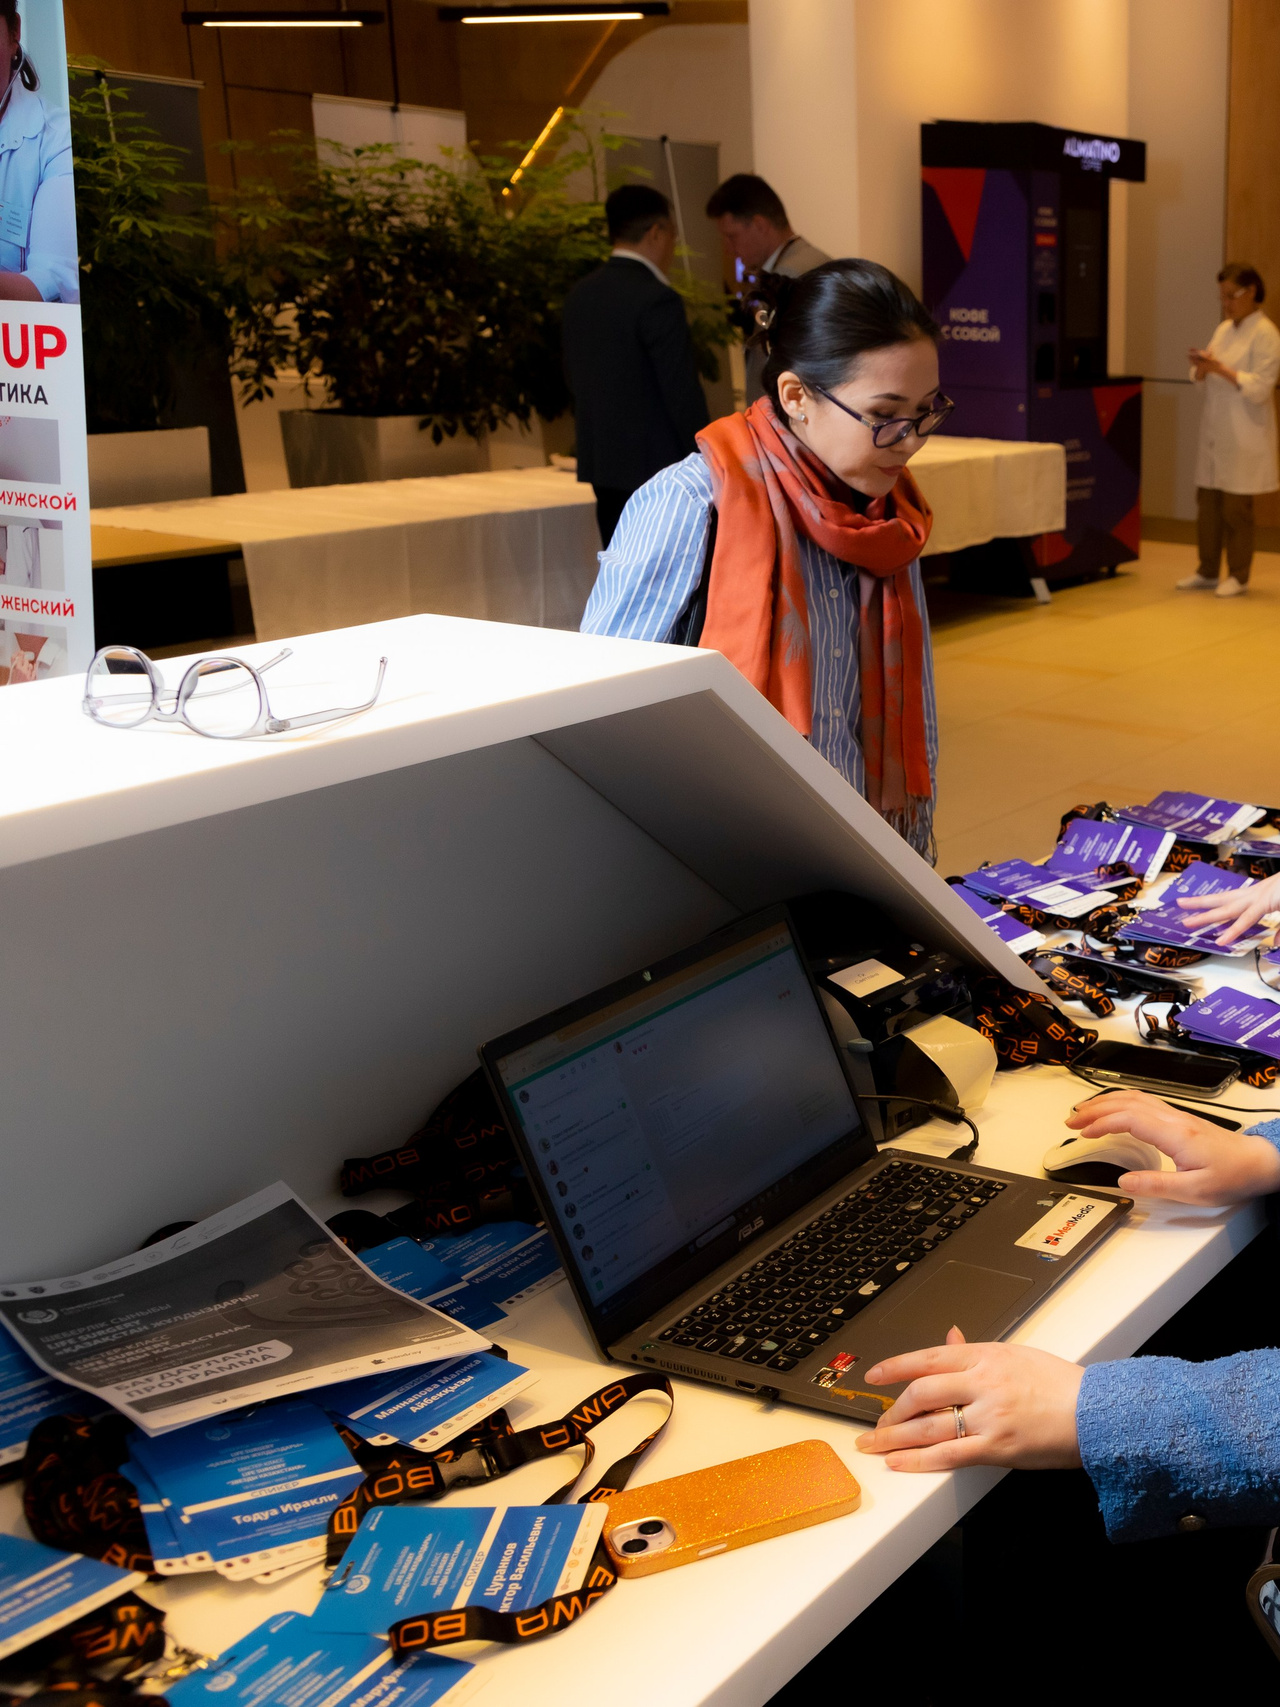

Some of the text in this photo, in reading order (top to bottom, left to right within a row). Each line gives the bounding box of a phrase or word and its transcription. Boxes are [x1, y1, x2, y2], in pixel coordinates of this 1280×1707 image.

[949, 307, 989, 324] КОФЕ
[951, 325, 1001, 342] СОБОЙ
[1, 322, 68, 370] UP
[1, 594, 75, 618] ЖЕНСКИЙ
[1051, 966, 1115, 1015] BOWA
[737, 1215, 765, 1243] ASUS
[1053, 1204, 1096, 1238] MedMedia
[125, 1353, 277, 1398] ПРОГРАММА
[373, 1357, 482, 1421] Маннапова Малика
[250, 1480, 300, 1499] СПИКЕР
[232, 1492, 340, 1526] Тодуа Иракли
[508, 1515, 547, 1581] Васильевич
[463, 1550, 486, 1588] СПИКЕР
[483, 1541, 518, 1597] Цуранков
